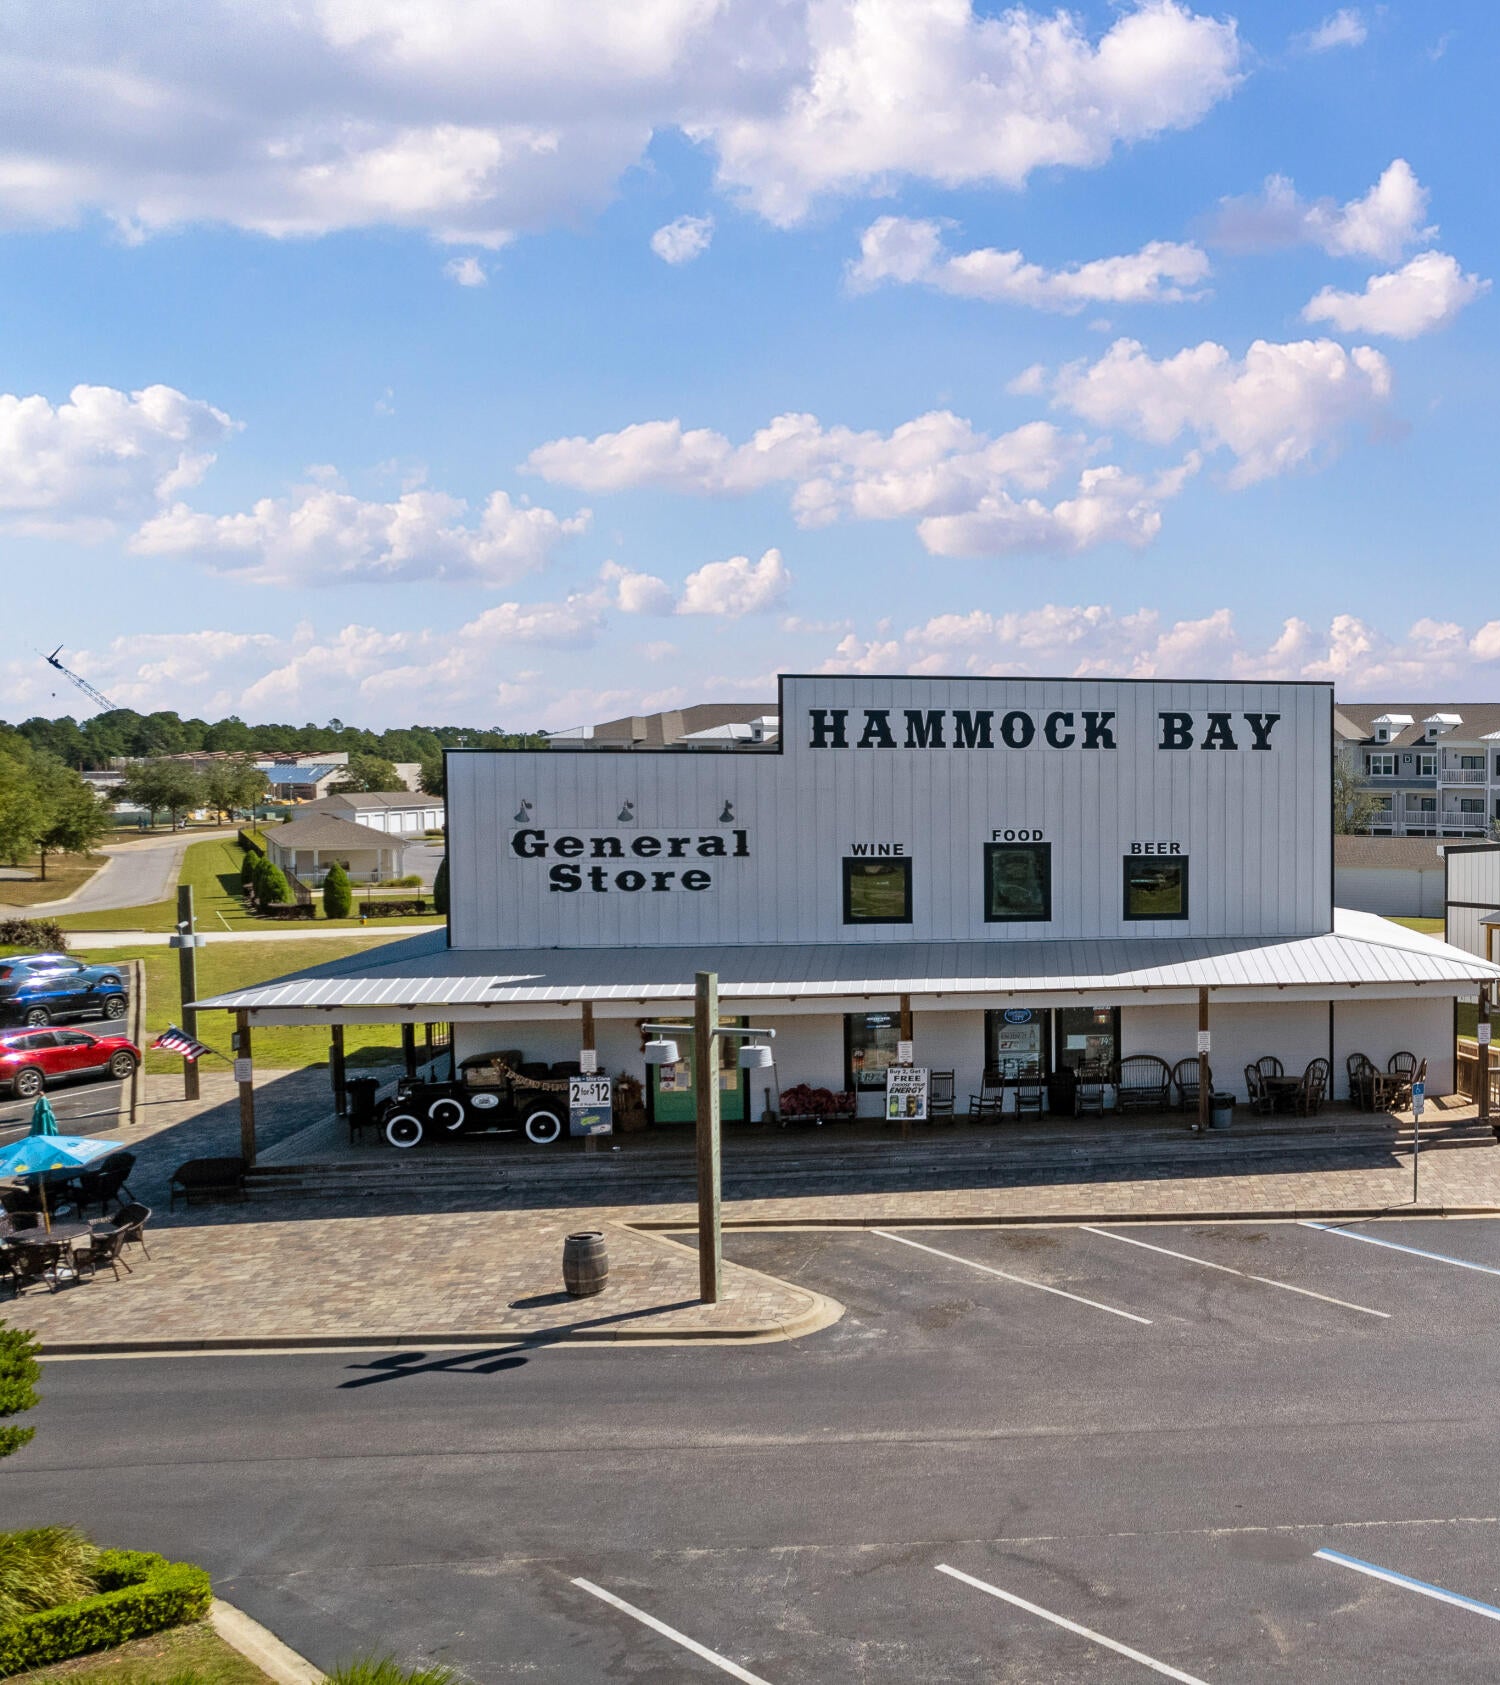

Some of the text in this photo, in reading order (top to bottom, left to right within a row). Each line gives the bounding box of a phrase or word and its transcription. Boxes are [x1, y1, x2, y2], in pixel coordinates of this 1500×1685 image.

[808, 709, 1281, 751] HAMMOCK BAY
[511, 829, 750, 858] General
[992, 829, 1044, 842] FOOD
[851, 843, 904, 856] WINE
[1131, 842, 1181, 854] BEER
[549, 864, 712, 892] Store
[572, 1083, 580, 1102] 2
[590, 1083, 609, 1102] $12
